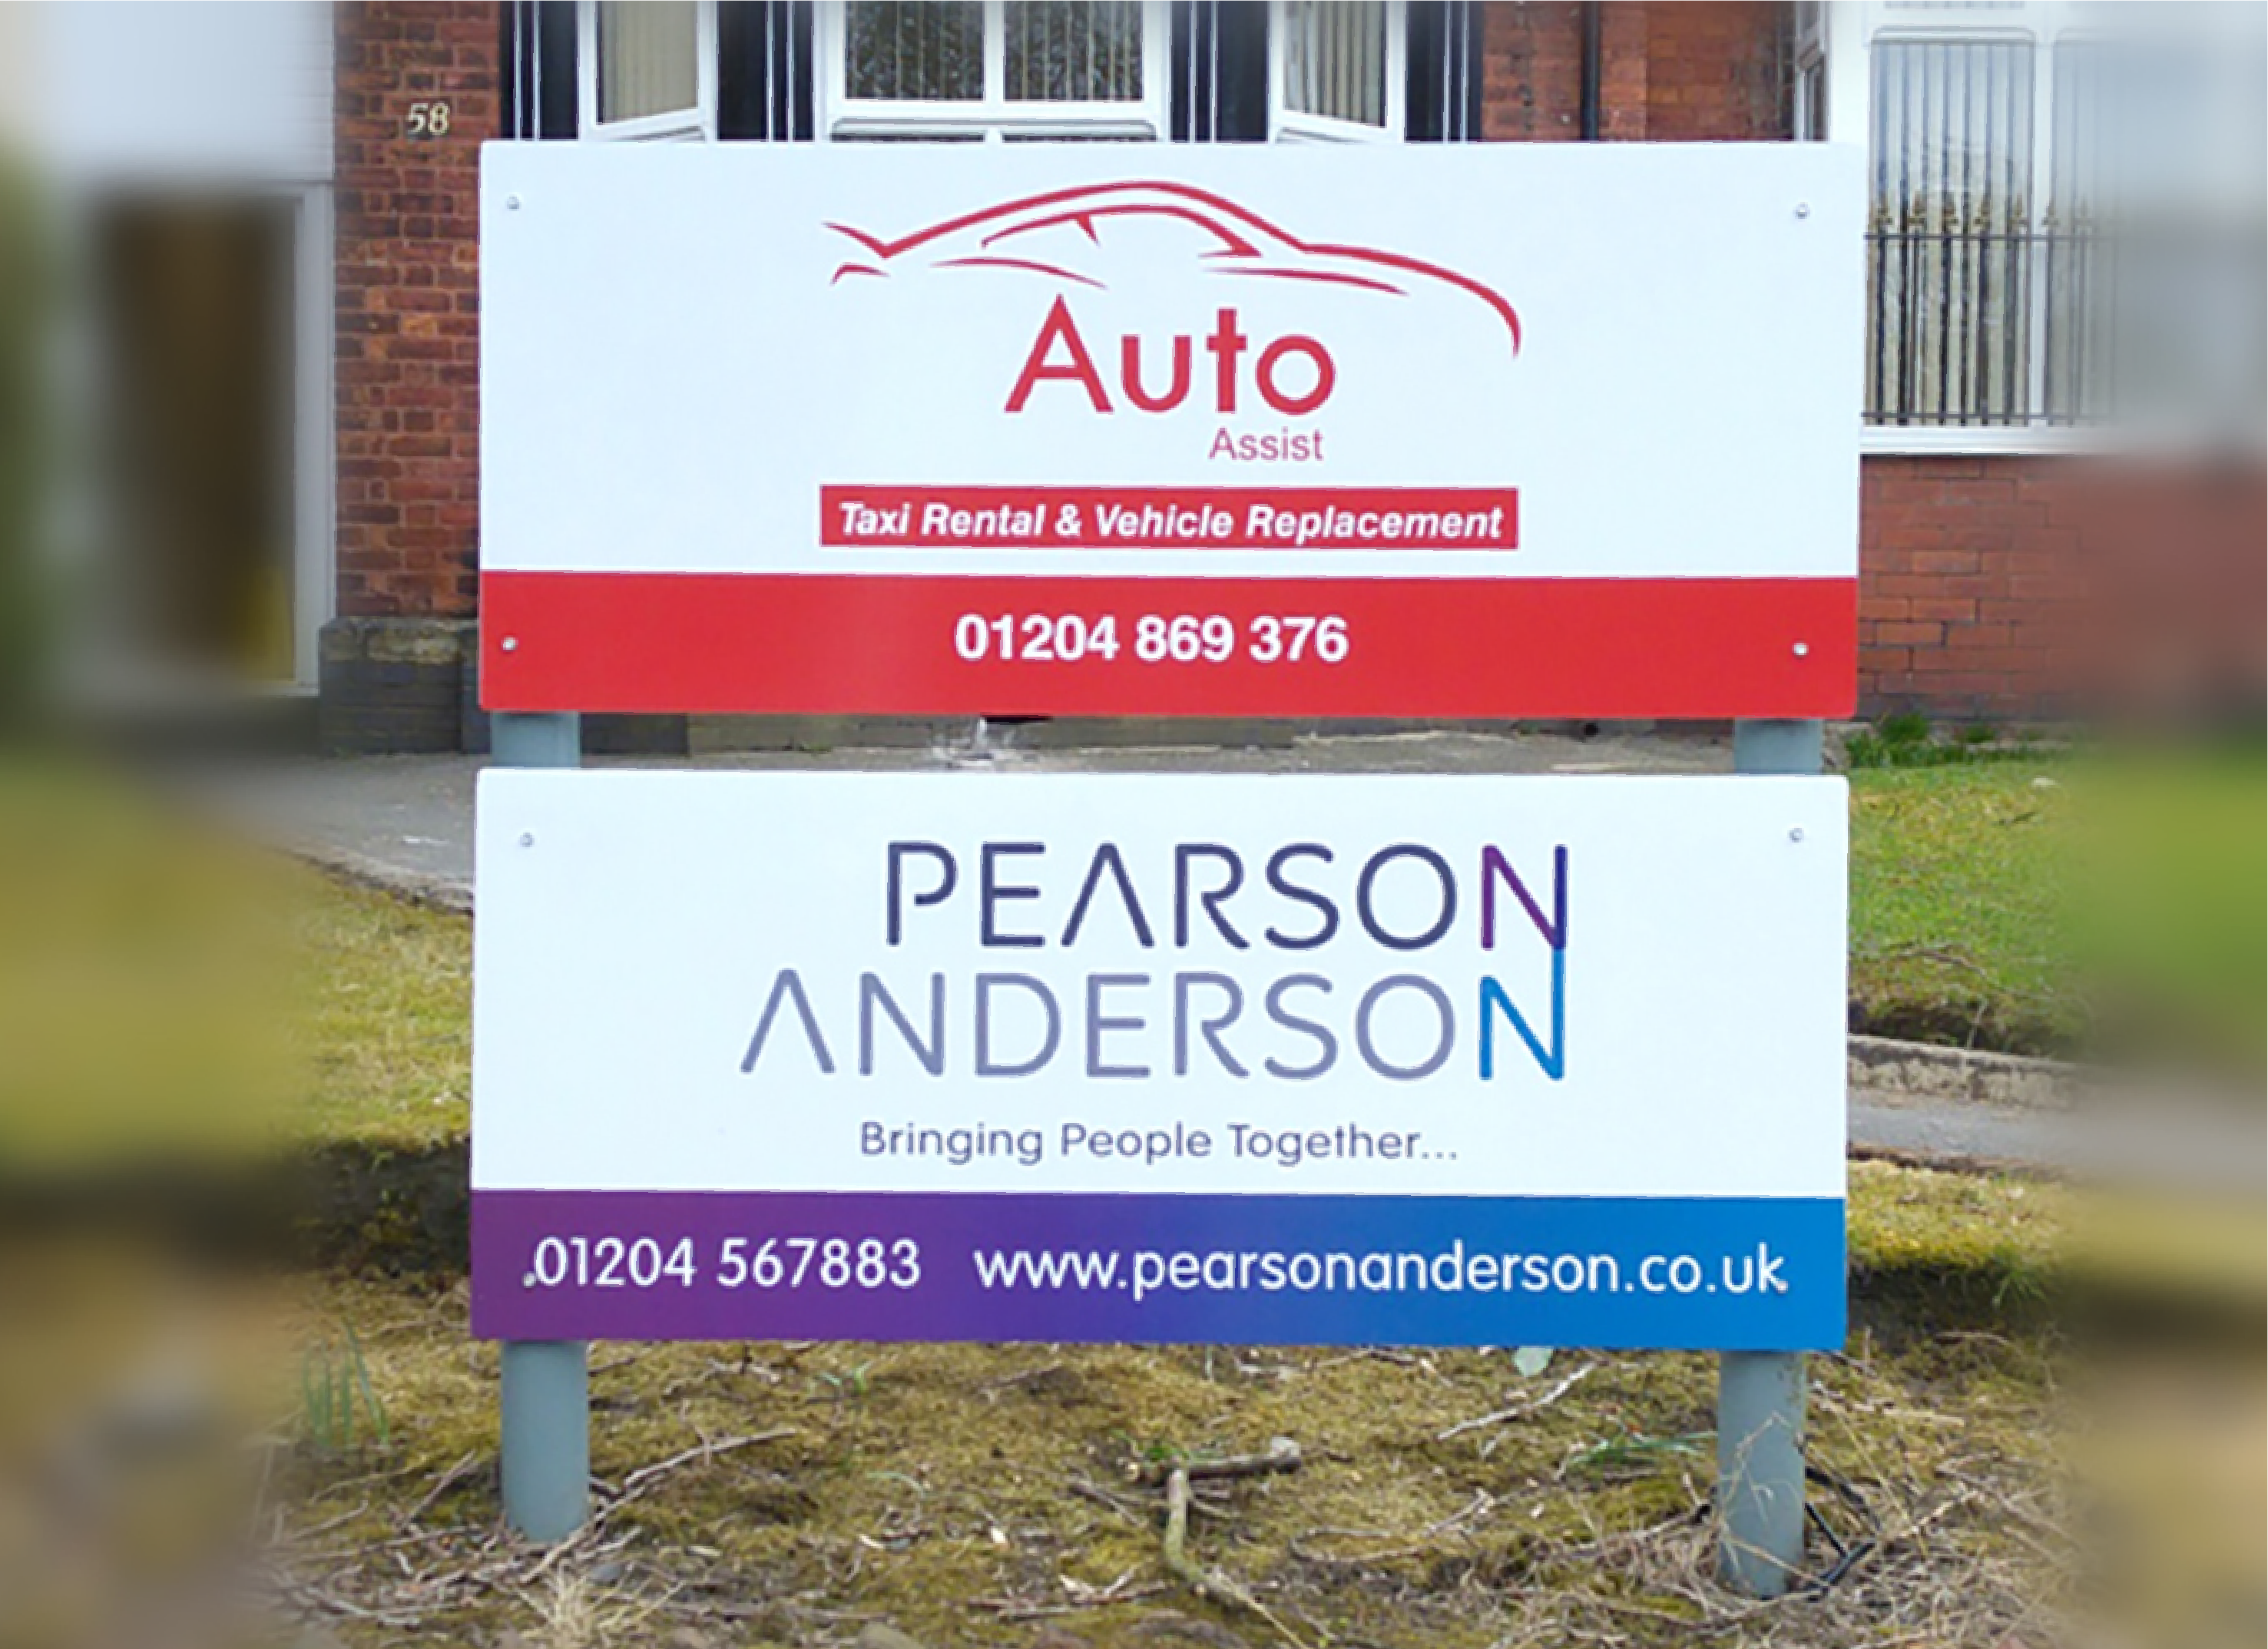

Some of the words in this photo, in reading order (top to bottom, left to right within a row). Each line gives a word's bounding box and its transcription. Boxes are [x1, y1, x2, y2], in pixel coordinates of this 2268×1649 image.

[407, 101, 451, 135] 58
[1003, 292, 1336, 416] Auto
[1209, 425, 1323, 462] Assist
[841, 502, 910, 536] Taxi
[921, 503, 1047, 538] Rental
[1055, 503, 1081, 537] &
[1096, 504, 1234, 538] Vehicle
[1245, 503, 1502, 545] Replacement
[955, 614, 1121, 661] 01204
[1136, 614, 1235, 663] 869
[1250, 615, 1349, 662] 376
[886, 841, 1568, 950] PEARSON
[740, 965, 1566, 1081] ANDERSON
[861, 1121, 1043, 1167] Bringing
[1061, 1121, 1211, 1166] People
[534, 1237, 695, 1286] 01204
[718, 1237, 919, 1288] 567883
[974, 1239, 1783, 1302] www.pearsonanderson.co.uk
